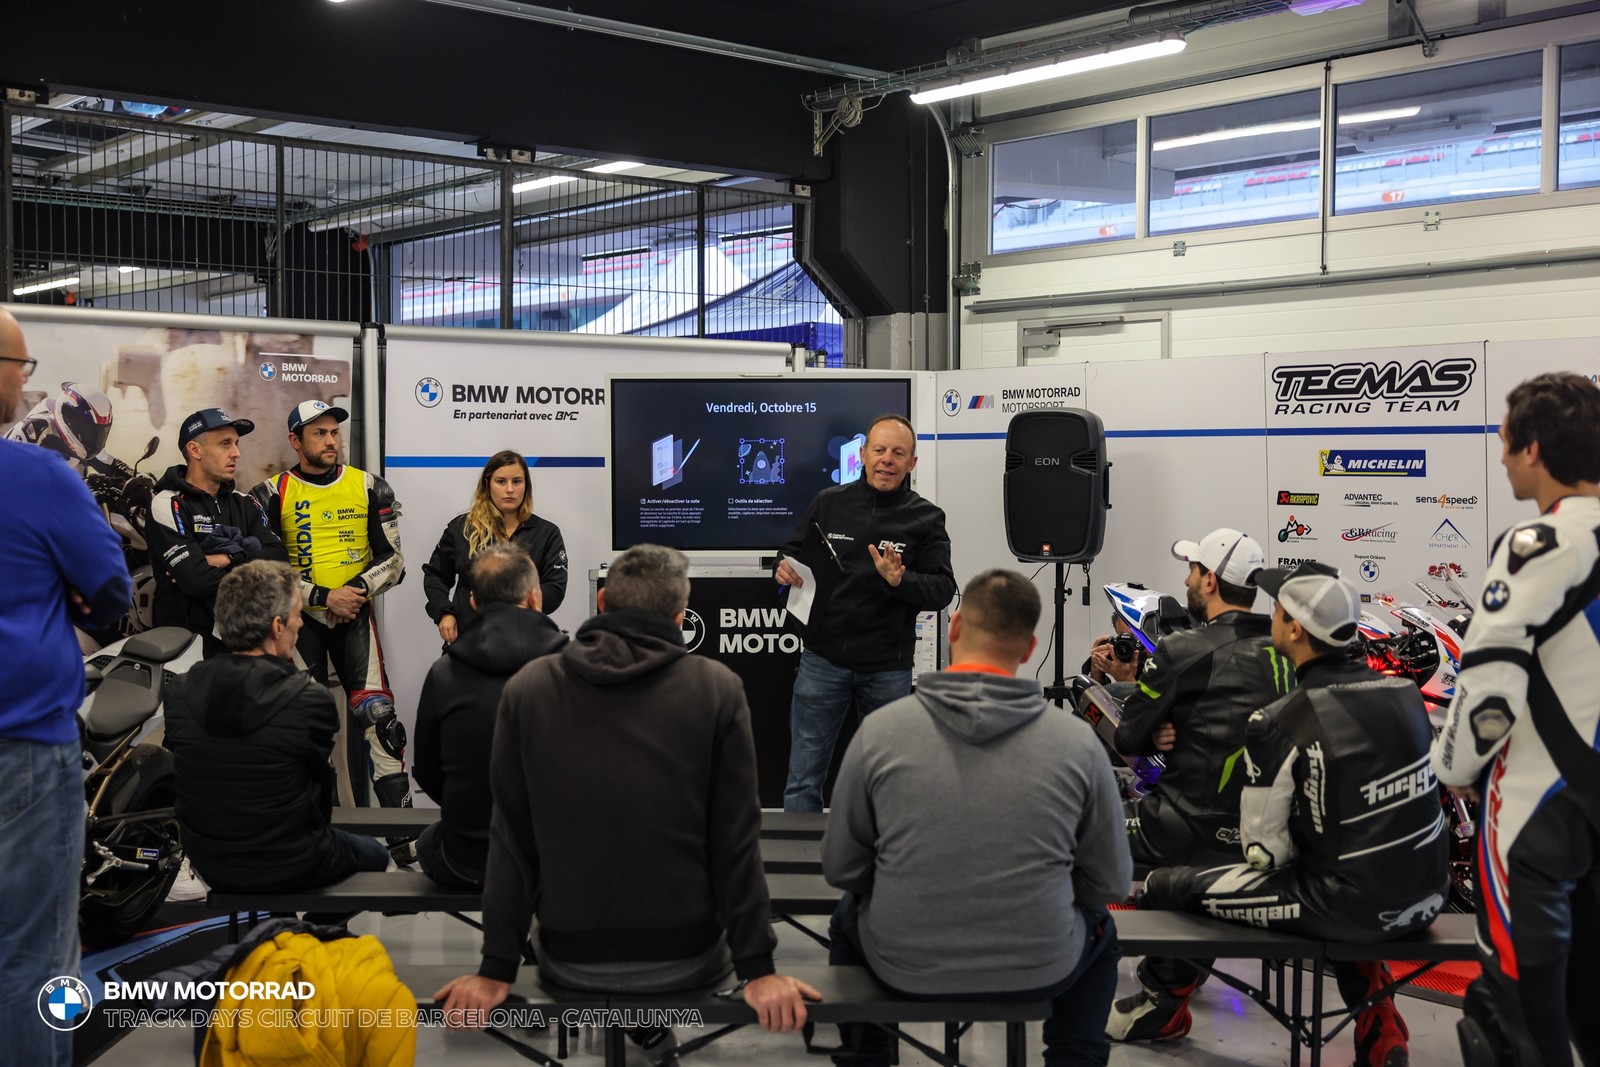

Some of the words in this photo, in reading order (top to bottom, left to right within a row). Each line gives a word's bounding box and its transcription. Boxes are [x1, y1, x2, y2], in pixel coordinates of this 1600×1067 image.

[282, 362, 308, 372] BMW
[282, 373, 338, 383] MOTORRAD
[1272, 358, 1476, 402] TECMAS
[452, 384, 509, 403] BMW
[516, 386, 605, 405] MOTORR
[1002, 389, 1025, 399] BMW
[1026, 387, 1081, 399] MOTORRAD
[706, 402, 757, 414] Vendredi,
[760, 402, 803, 413] Octobre
[805, 402, 817, 412] 15
[1274, 402, 1371, 415] RACING
[1385, 400, 1460, 413] TEAM
[454, 410, 466, 419] En
[468, 410, 528, 421] partenariat
[555, 411, 579, 420] BMC
[1034, 458, 1060, 466] EON
[1348, 459, 1424, 469] MICHELIN
[1416, 494, 1474, 508] sens4speed
[720, 608, 788, 628] BMW
[720, 633, 804, 654] MOTO
